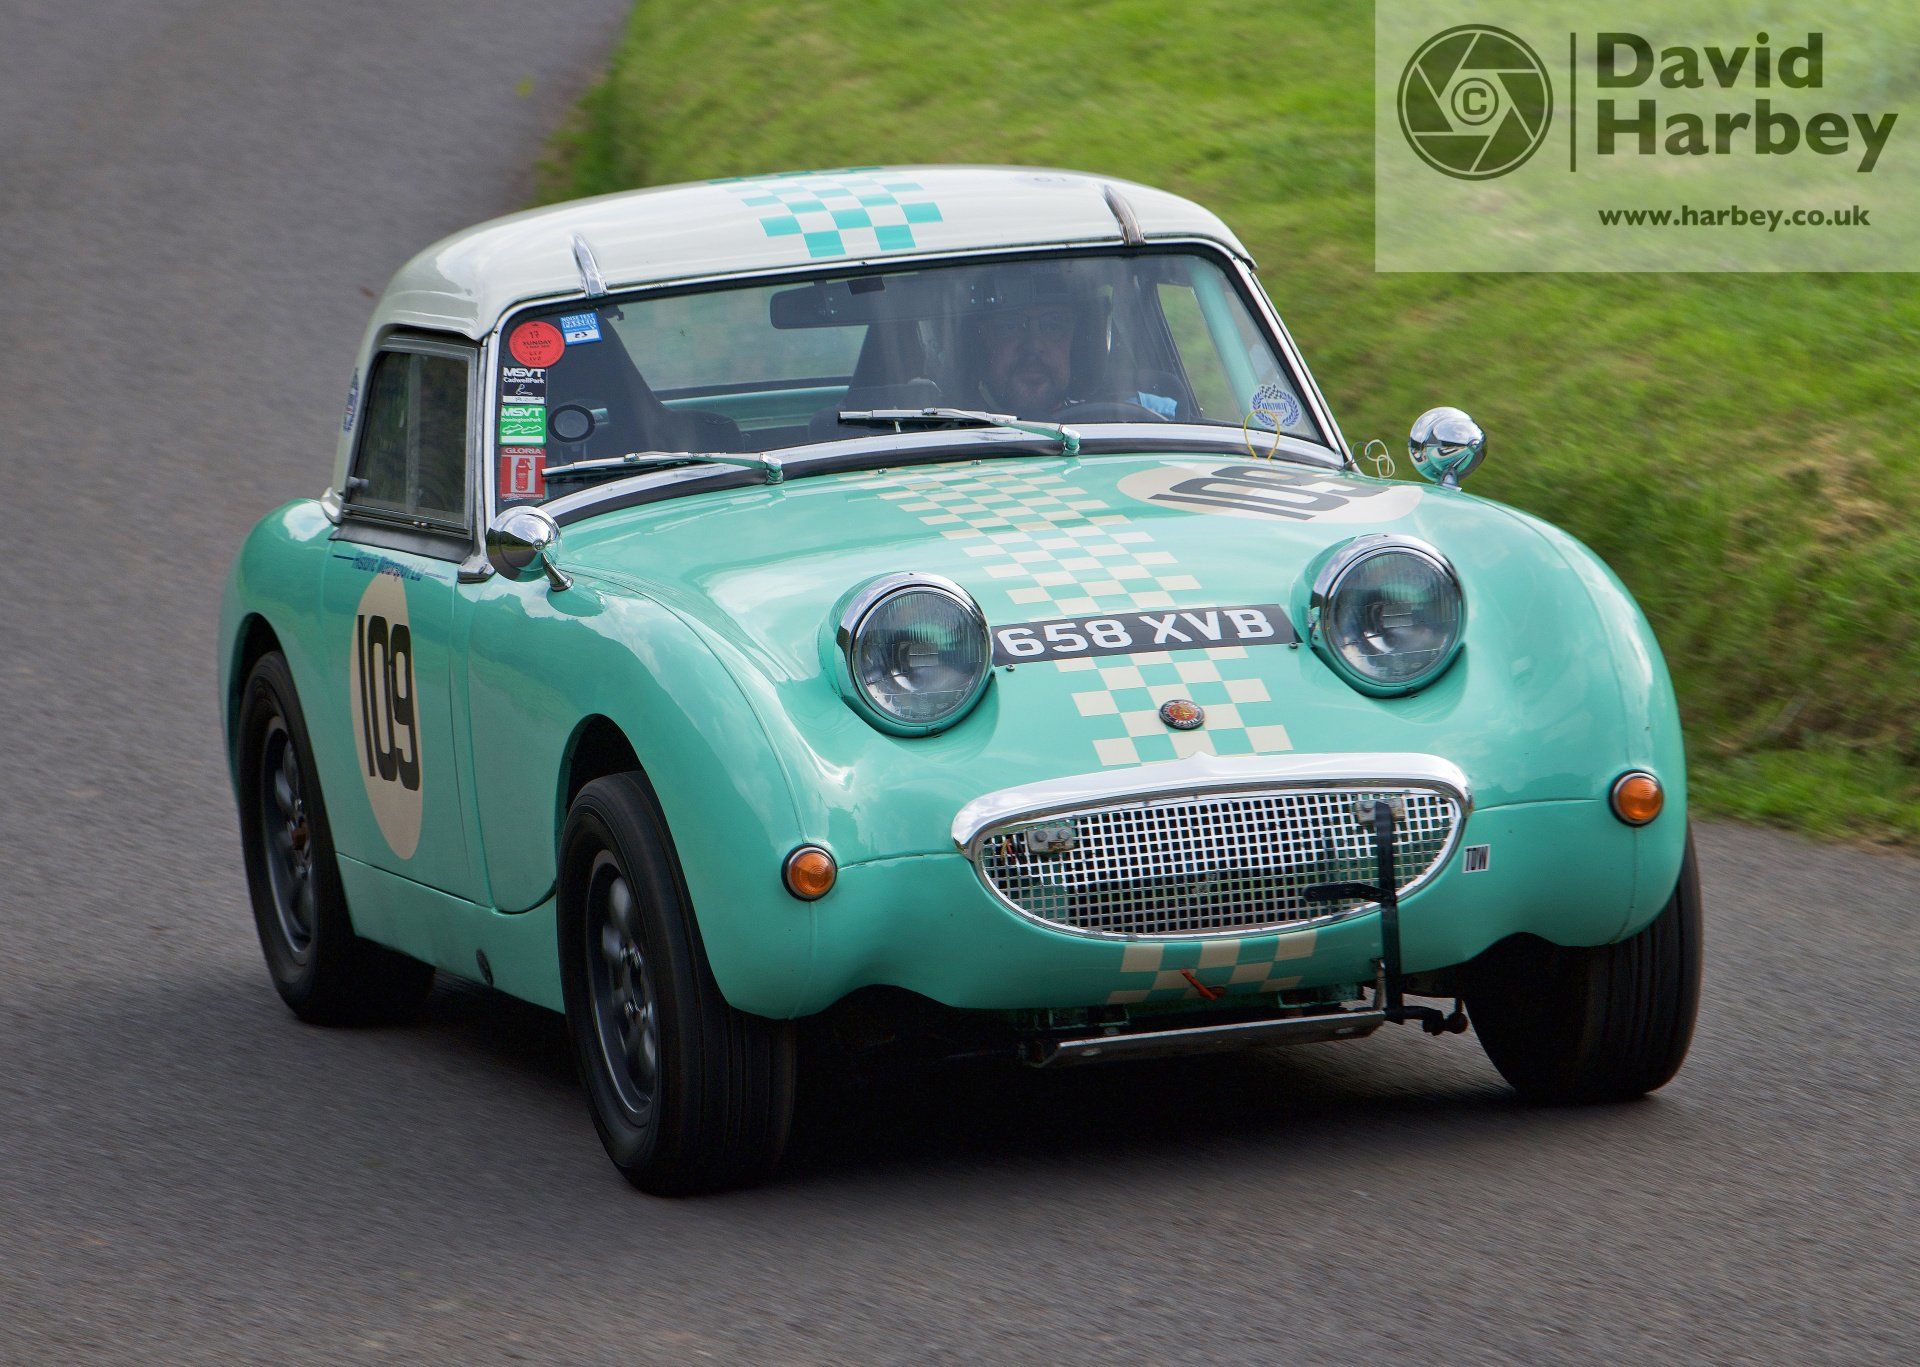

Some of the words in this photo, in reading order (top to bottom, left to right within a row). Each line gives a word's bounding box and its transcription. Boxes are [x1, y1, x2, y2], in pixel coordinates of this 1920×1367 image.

[503, 367, 545, 377] MSVT
[501, 407, 543, 417] MSVT
[505, 447, 542, 455] GLORIA
[1148, 465, 1391, 521] 109
[997, 619, 1133, 657] 658
[1138, 609, 1275, 645] XVB
[357, 615, 420, 791] 109
